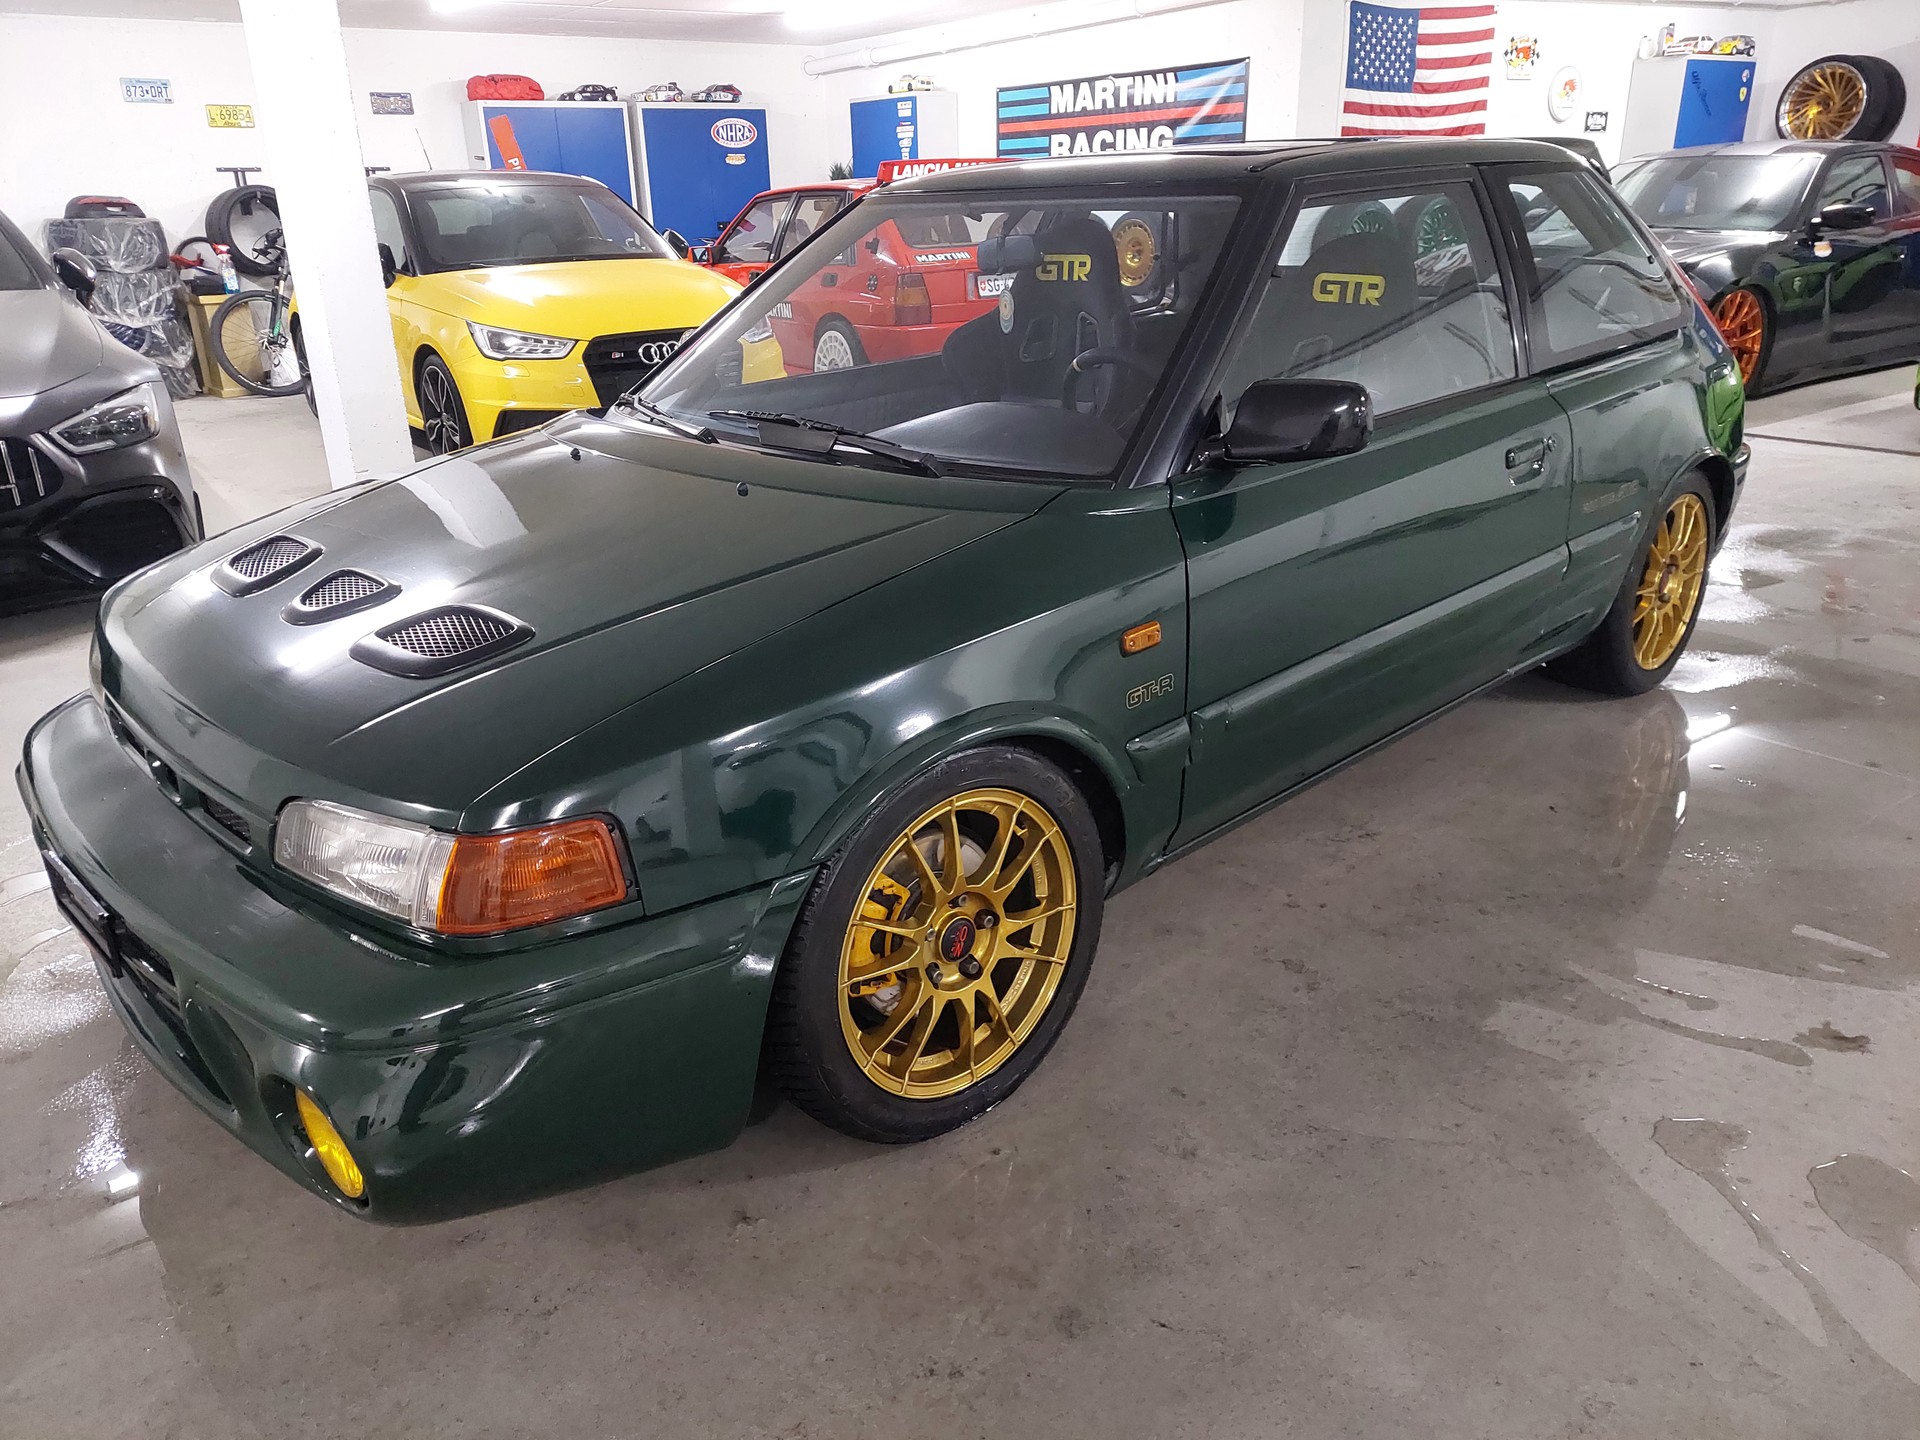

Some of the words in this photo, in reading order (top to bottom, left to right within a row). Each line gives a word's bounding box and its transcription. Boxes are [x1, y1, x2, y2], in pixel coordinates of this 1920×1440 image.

[125, 85, 146, 98] 873
[1050, 72, 1176, 115] MARTINI
[718, 124, 750, 142] NHRA
[1050, 125, 1175, 156] RACING
[892, 162, 951, 180] LANCIA
[915, 251, 972, 264] MARTINI
[1035, 254, 1092, 282] GTR
[1312, 272, 1386, 306] GTR
[1126, 673, 1175, 710] GT-R
